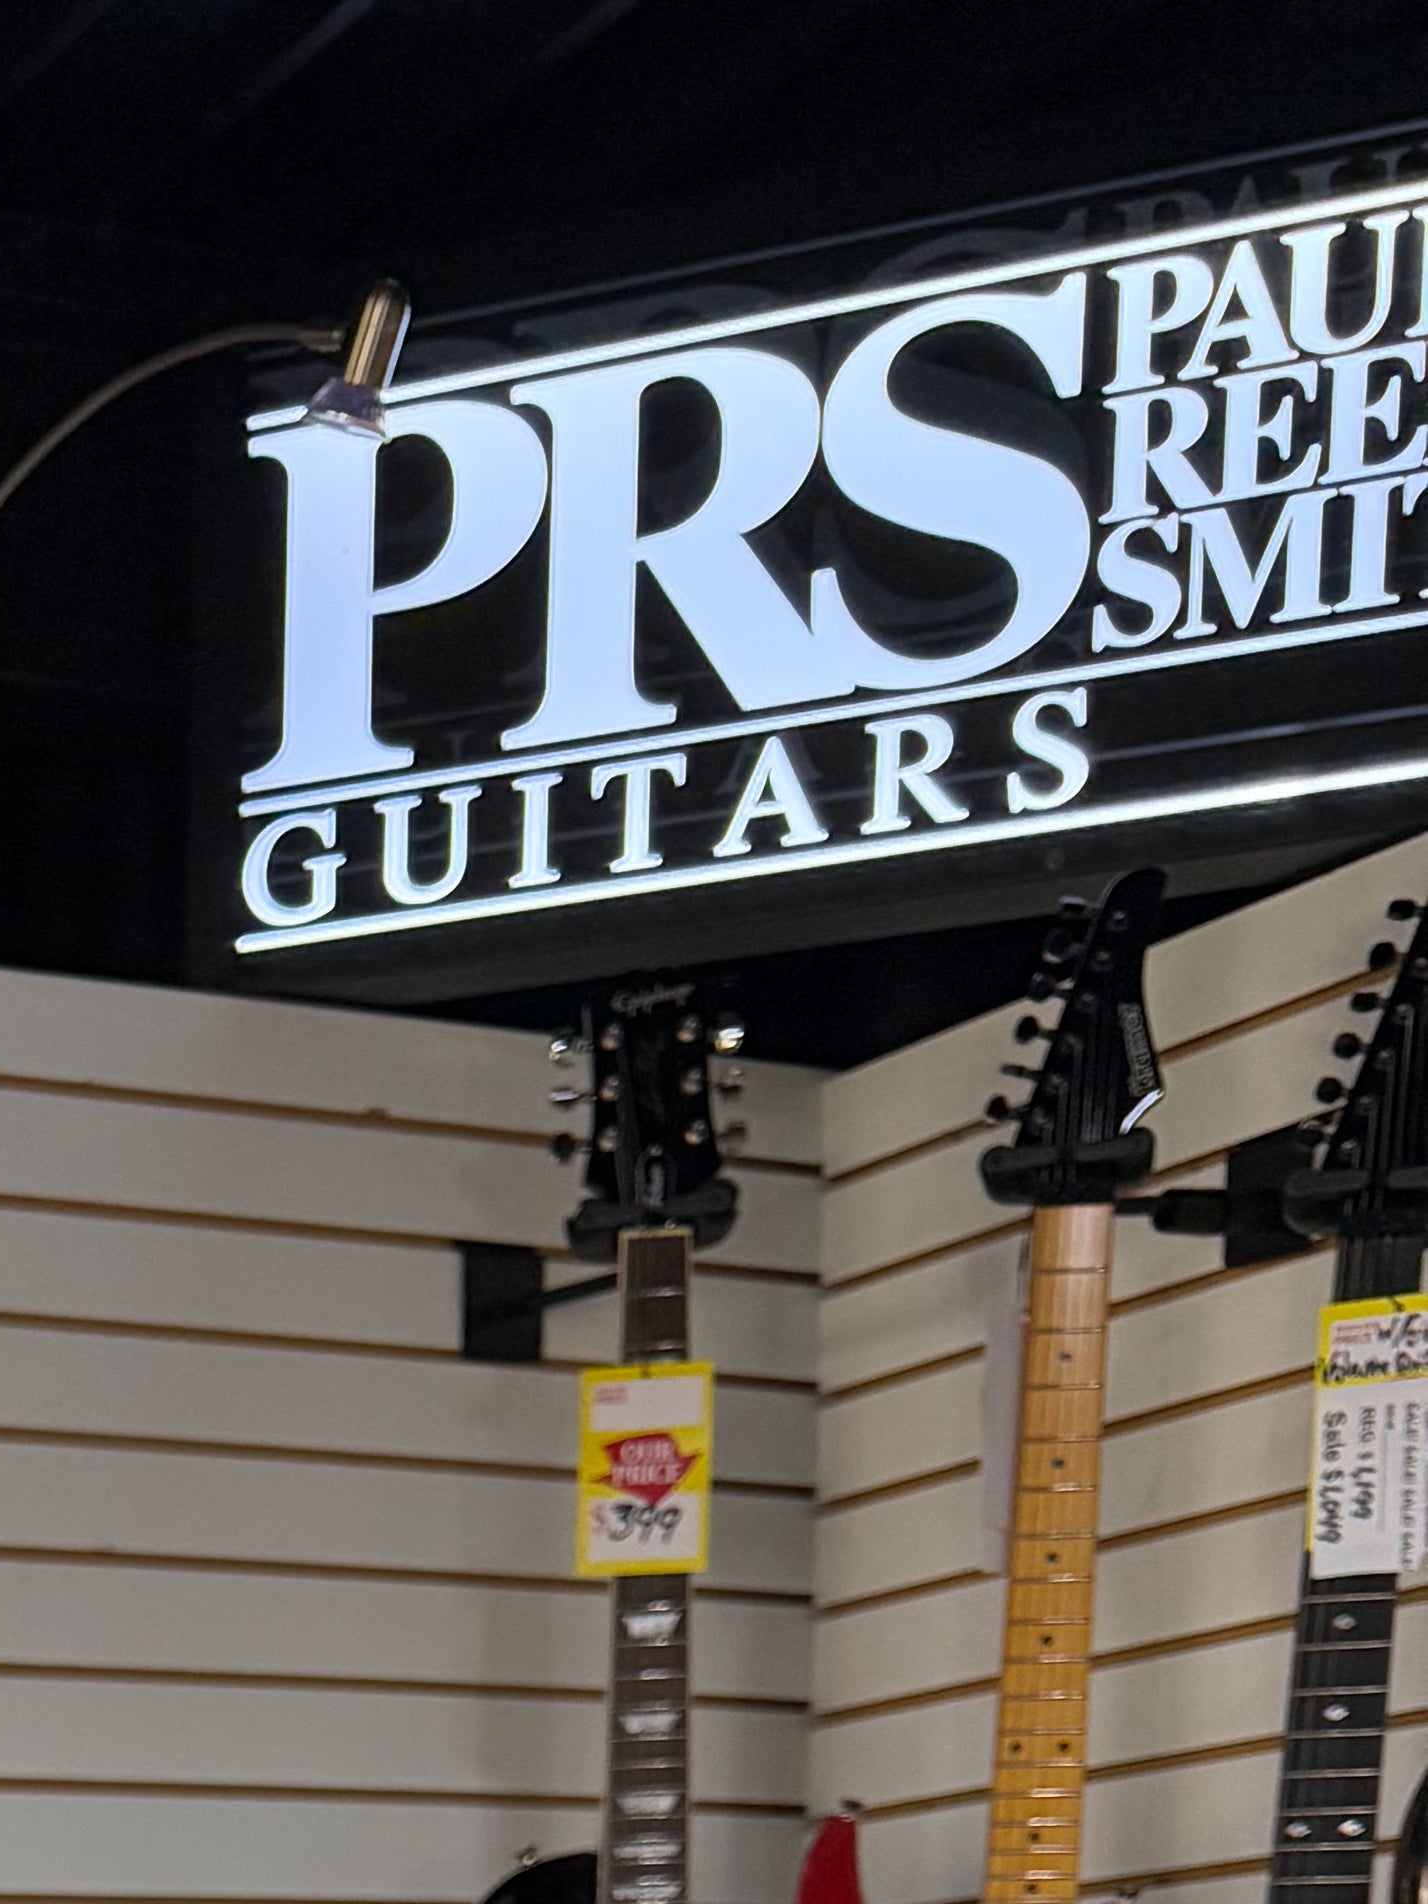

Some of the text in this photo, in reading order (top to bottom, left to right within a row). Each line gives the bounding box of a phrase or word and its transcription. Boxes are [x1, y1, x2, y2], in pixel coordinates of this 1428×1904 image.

[1102, 206, 1428, 395] PAU
[1098, 341, 1428, 525] REE
[240, 270, 1091, 794] PRS
[1092, 474, 1428, 654] SMI
[240, 686, 1091, 928] GUITARS
